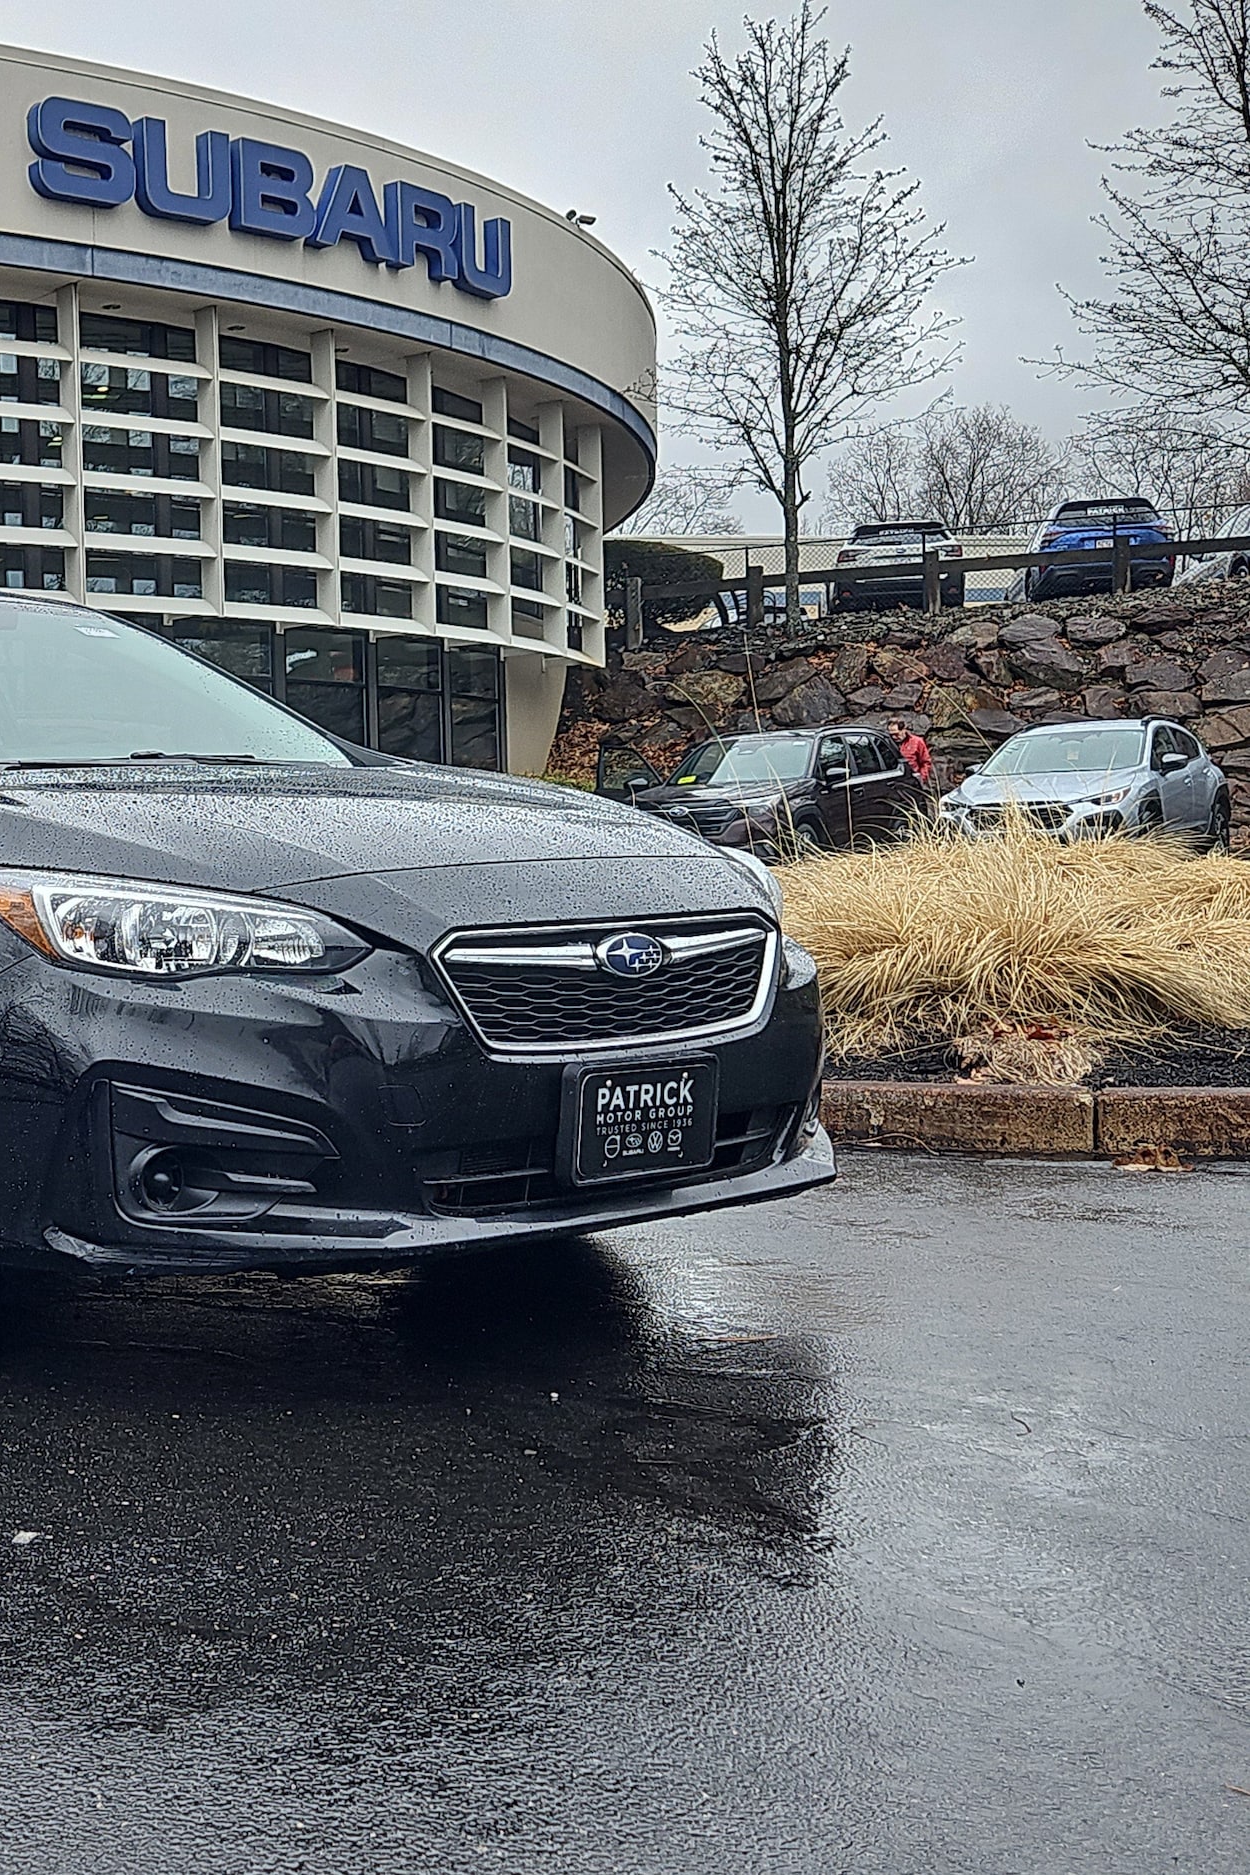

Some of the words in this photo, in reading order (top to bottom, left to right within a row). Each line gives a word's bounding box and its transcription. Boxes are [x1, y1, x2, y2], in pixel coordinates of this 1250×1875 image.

[27, 95, 511, 300] SUBARU
[597, 1079, 695, 1113] PATRICK
[596, 1109, 642, 1126] MOTOR
[649, 1104, 694, 1120] GROUP
[596, 1123, 638, 1136] TRUSTED
[641, 1120, 669, 1132] SINCE
[672, 1117, 693, 1128] 1936
